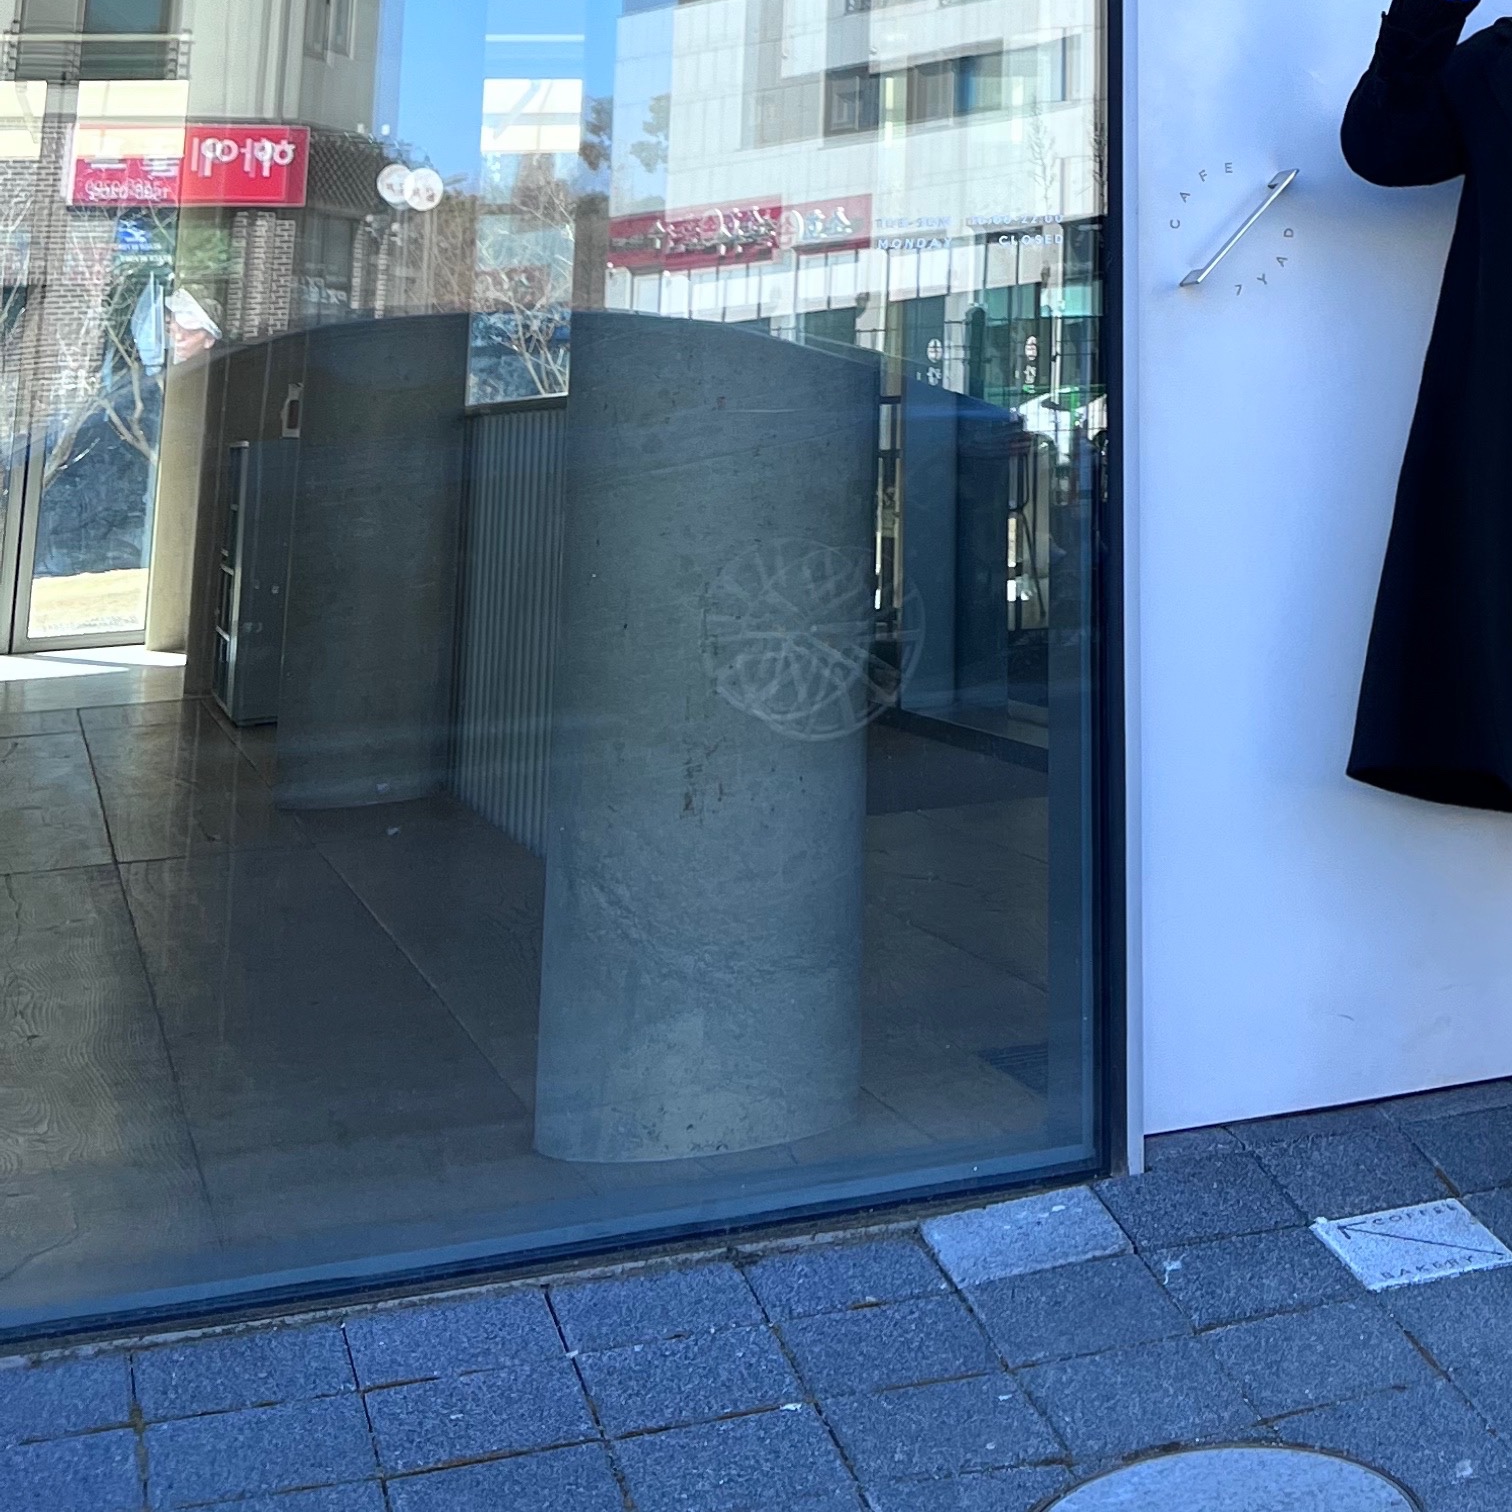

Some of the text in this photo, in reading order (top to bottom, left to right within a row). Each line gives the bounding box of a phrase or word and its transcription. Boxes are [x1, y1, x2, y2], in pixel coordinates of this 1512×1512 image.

[1169, 162, 1234, 230] CAFE
[877, 234, 1065, 250] MONDAY CLOSED
[1371, 1203, 1457, 1226] COFFEE
[1381, 1254, 1474, 1280] BAKERY
